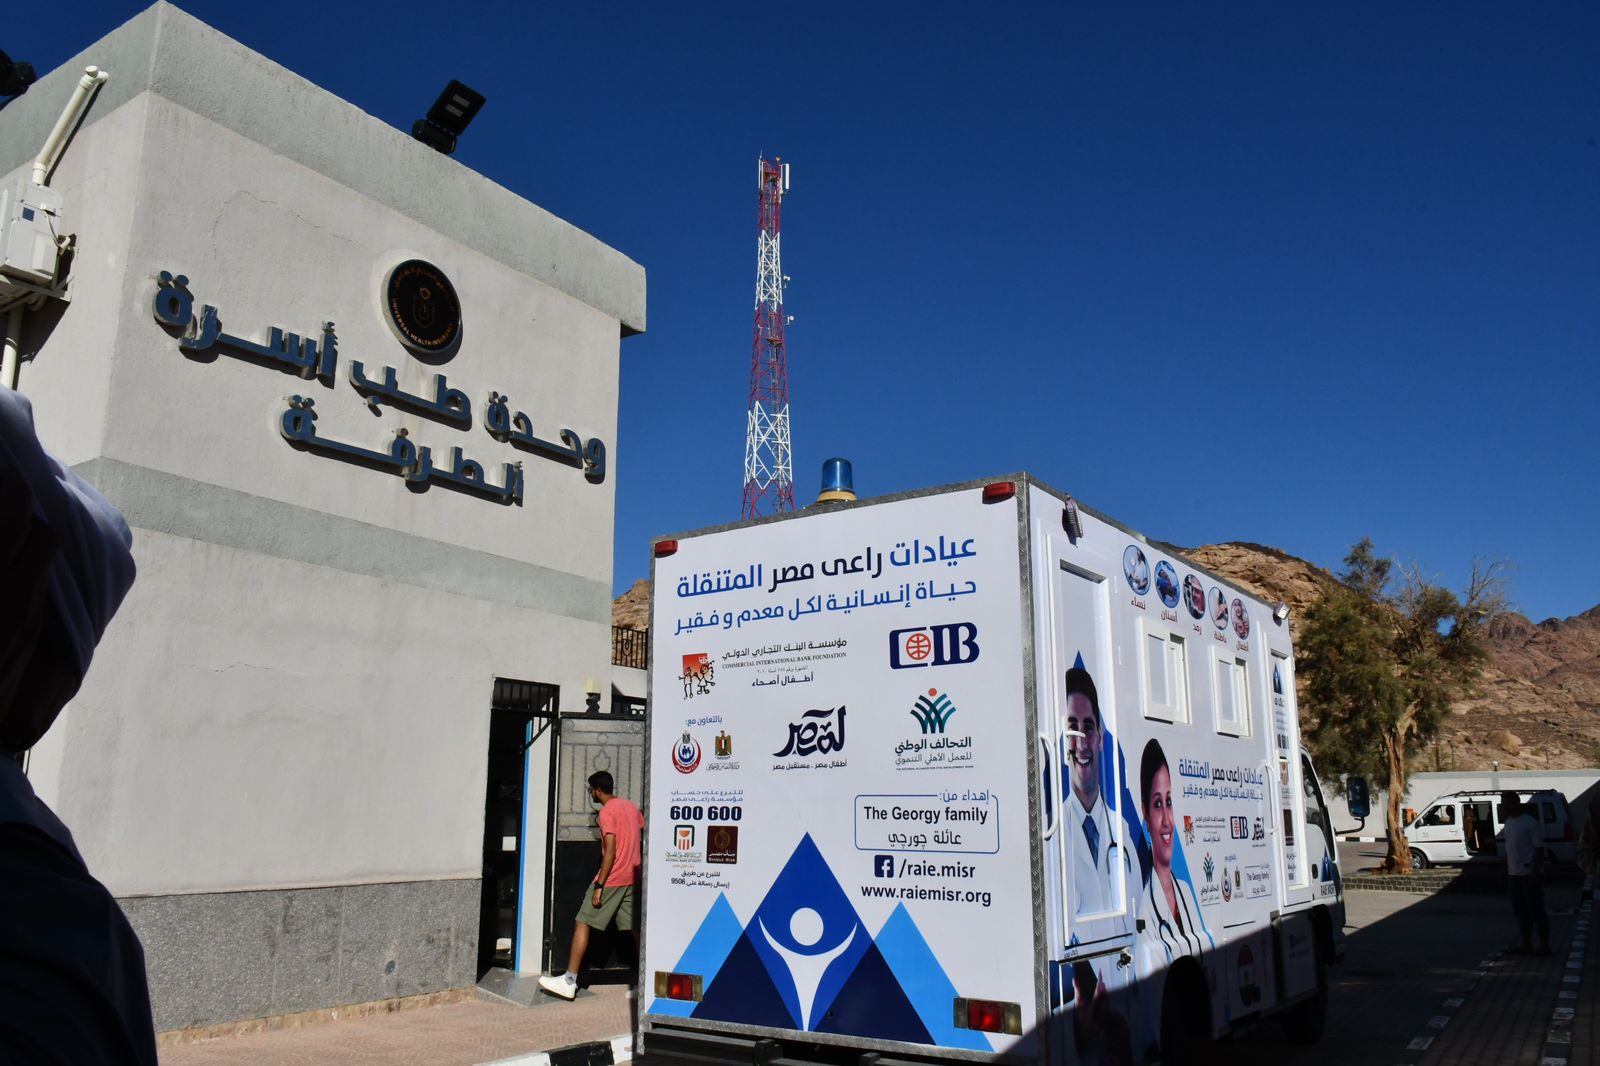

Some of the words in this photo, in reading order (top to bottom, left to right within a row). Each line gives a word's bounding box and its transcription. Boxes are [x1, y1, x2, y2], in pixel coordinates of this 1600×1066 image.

[153, 270, 335, 377] أسرة
[410, 333, 432, 346] HEALTH
[349, 359, 471, 420] طب
[484, 391, 606, 476] وحدة
[889, 535, 977, 567] عيادات
[677, 563, 762, 598] المتنقلة
[767, 562, 815, 593] مصر
[826, 583, 911, 614] إنسانية
[915, 580, 976, 602] حياة
[737, 605, 784, 628] معدم
[788, 595, 822, 621] لكل
[752, 644, 782, 657] التجاري
[784, 642, 806, 652] البنك
[808, 638, 847, 649] مؤسسة
[889, 622, 980, 670] CIB
[722, 661, 754, 670] COMMERCIAL
[756, 657, 796, 666] INTERNATIONAL
[812, 652, 847, 661] FOUNDATION
[781, 671, 814, 686] أطفال
[894, 738, 927, 756] الوطني
[930, 736, 972, 750] التحالف
[1178, 758, 1210, 779] المتنقلة
[1212, 767, 1225, 786] مصر
[962, 789, 990, 805] إهداء
[670, 806, 703, 820] 600
[708, 806, 742, 821] 600
[864, 806, 888, 820] The
[892, 806, 940, 824] Georgy
[945, 807, 988, 825] family
[934, 828, 962, 845] عائلة
[861, 885, 992, 907] www.raiemisr.org
